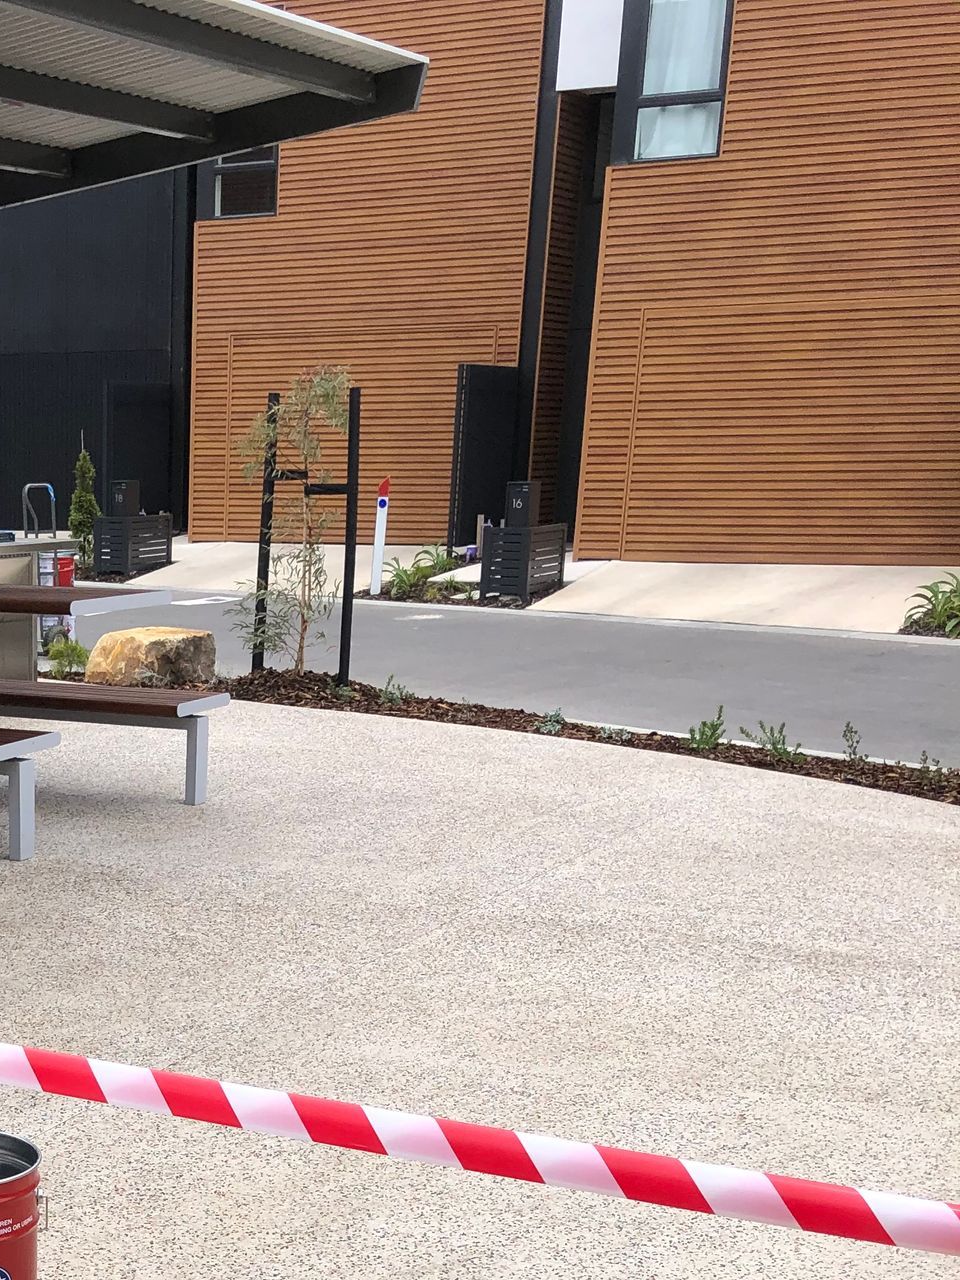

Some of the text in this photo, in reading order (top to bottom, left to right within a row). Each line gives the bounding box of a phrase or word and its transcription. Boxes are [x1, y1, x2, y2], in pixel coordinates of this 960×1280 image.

[115, 493, 123, 503] 18
[512, 498, 522, 508] 16
[12, 1223, 21, 1232] OR
